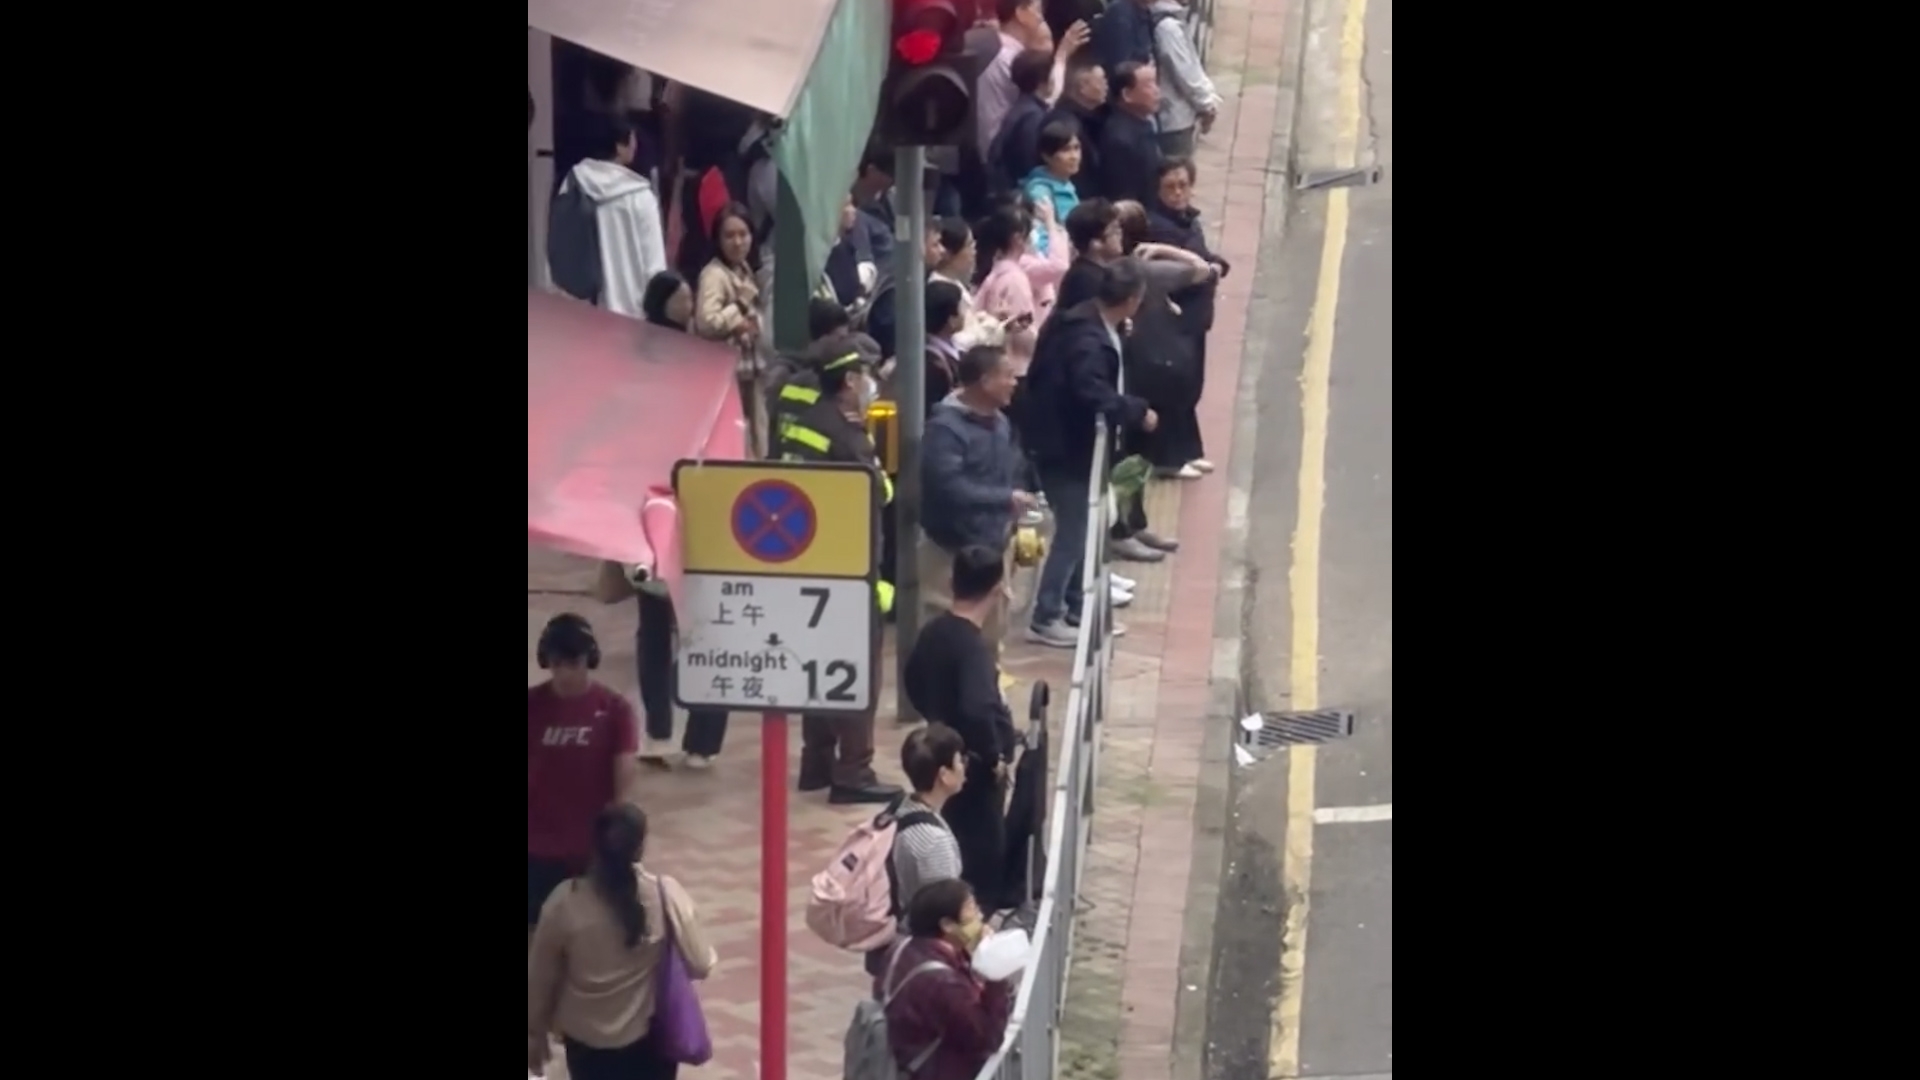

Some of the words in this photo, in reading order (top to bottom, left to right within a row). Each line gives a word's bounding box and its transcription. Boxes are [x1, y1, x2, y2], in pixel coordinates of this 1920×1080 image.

[721, 581, 753, 596] am
[711, 602, 765, 626] 上午
[800, 587, 830, 628] 7
[688, 650, 788, 673] midnight
[711, 674, 764, 699] 午夜
[801, 660, 857, 702] 12
[542, 727, 592, 746] UFC
